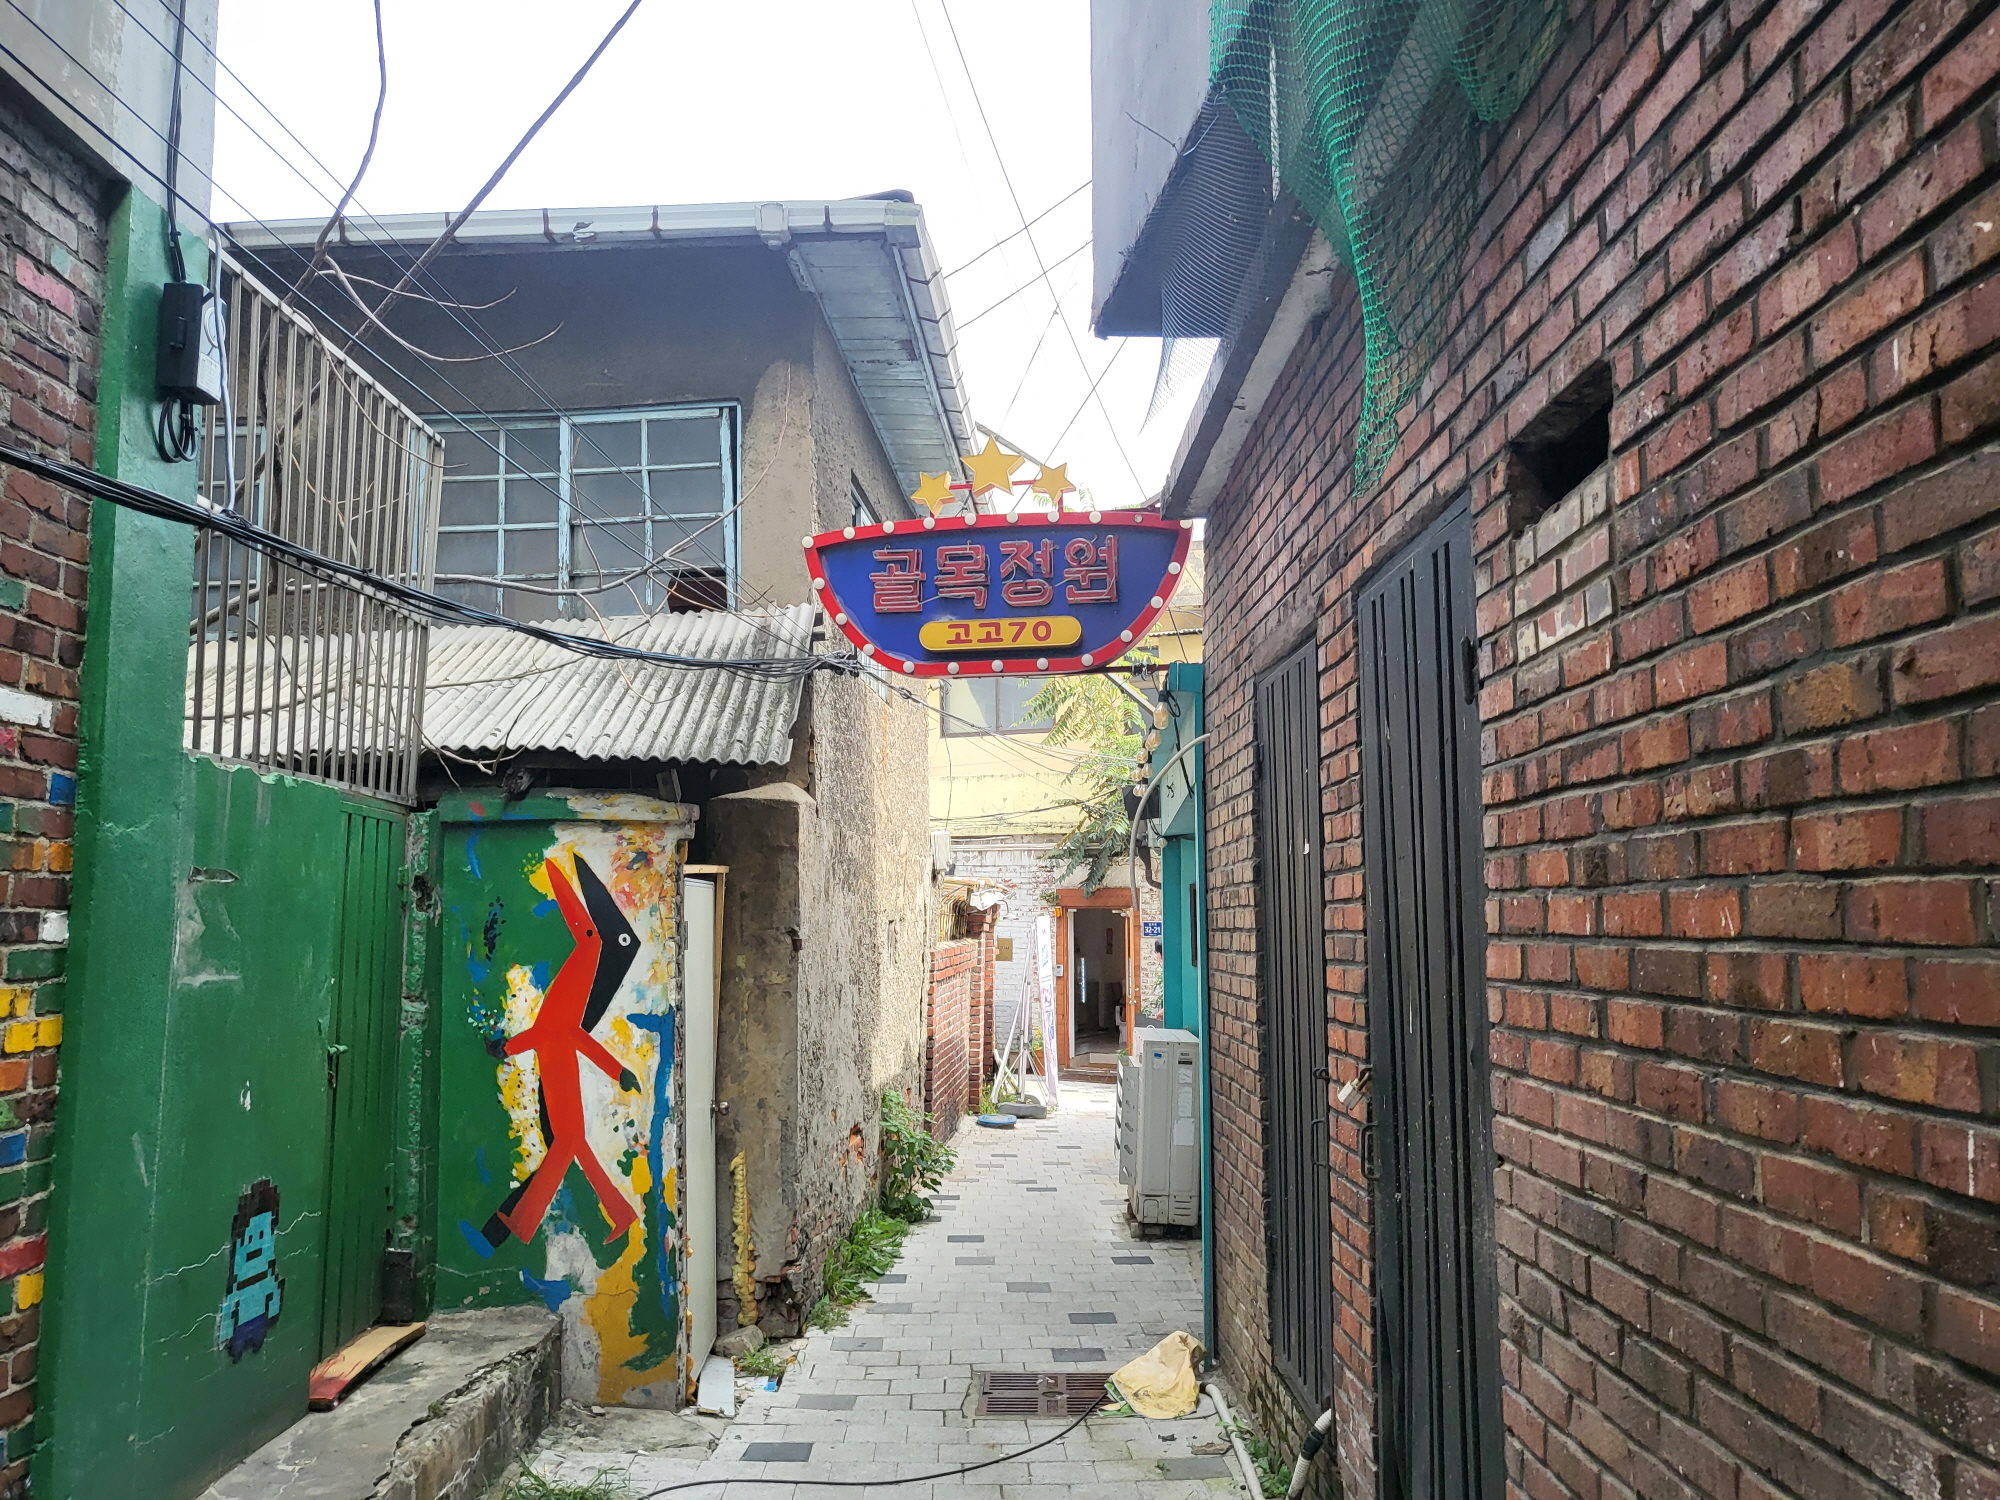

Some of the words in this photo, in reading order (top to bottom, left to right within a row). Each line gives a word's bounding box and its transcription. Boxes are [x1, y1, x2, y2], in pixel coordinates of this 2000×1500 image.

[869, 535, 1118, 613] 골목정원
[946, 620, 1052, 645] 고고70
[1144, 926, 1161, 934] 32-21
